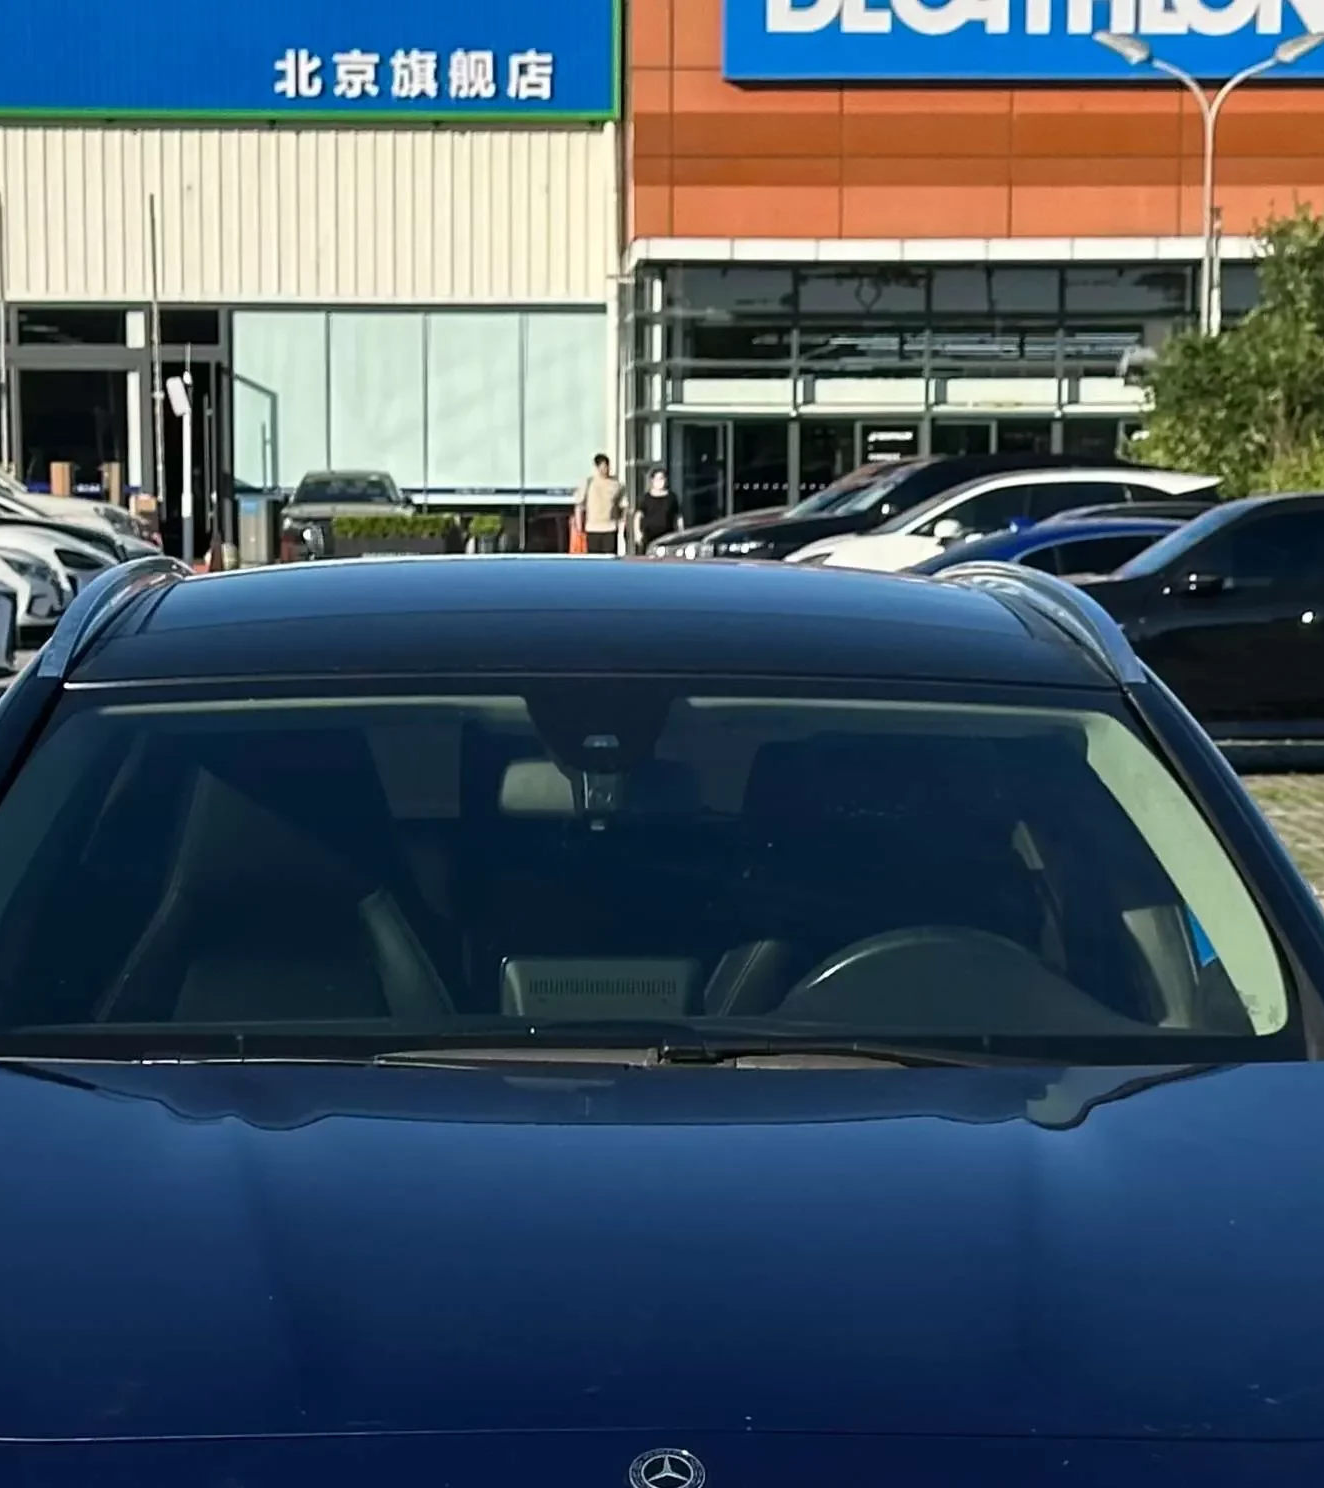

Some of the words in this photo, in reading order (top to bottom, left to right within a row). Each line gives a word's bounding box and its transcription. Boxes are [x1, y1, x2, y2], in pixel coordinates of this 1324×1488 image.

[274, 48, 554, 99] 北京旗舰店
